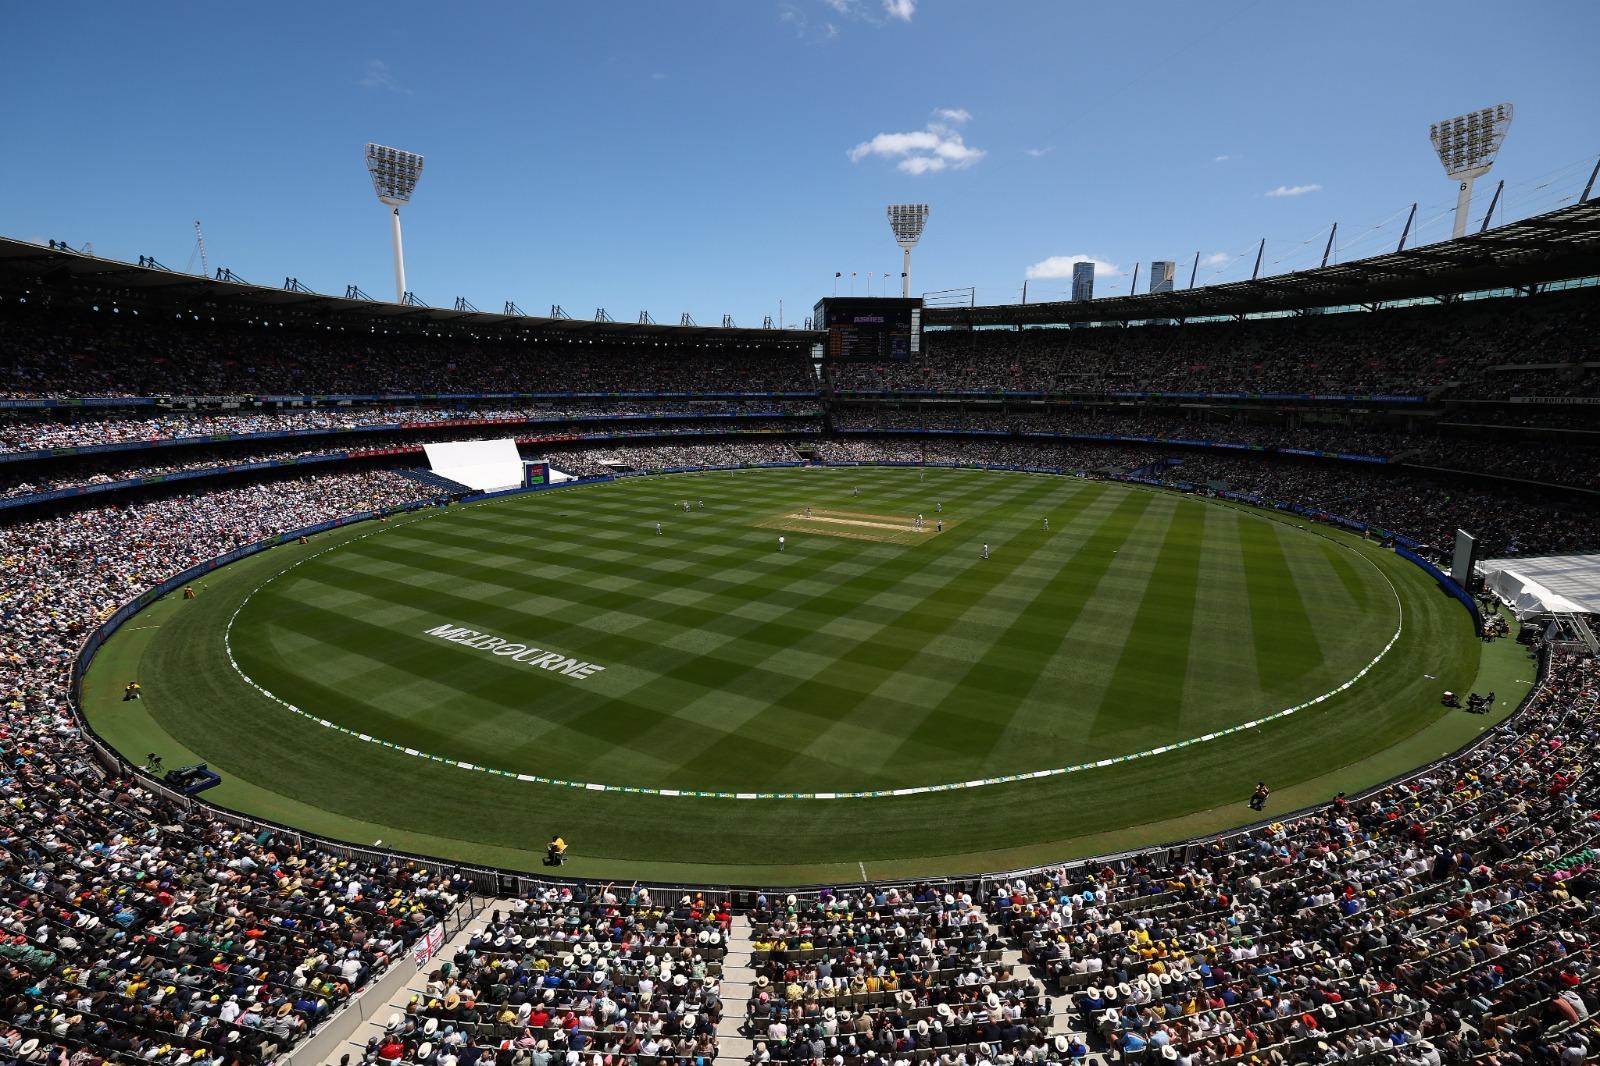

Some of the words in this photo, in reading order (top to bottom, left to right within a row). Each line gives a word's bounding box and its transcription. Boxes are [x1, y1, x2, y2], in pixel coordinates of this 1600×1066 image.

[1460, 182, 1467, 191] 6
[393, 208, 399, 216] 4
[423, 623, 606, 680] MELBOURNE
